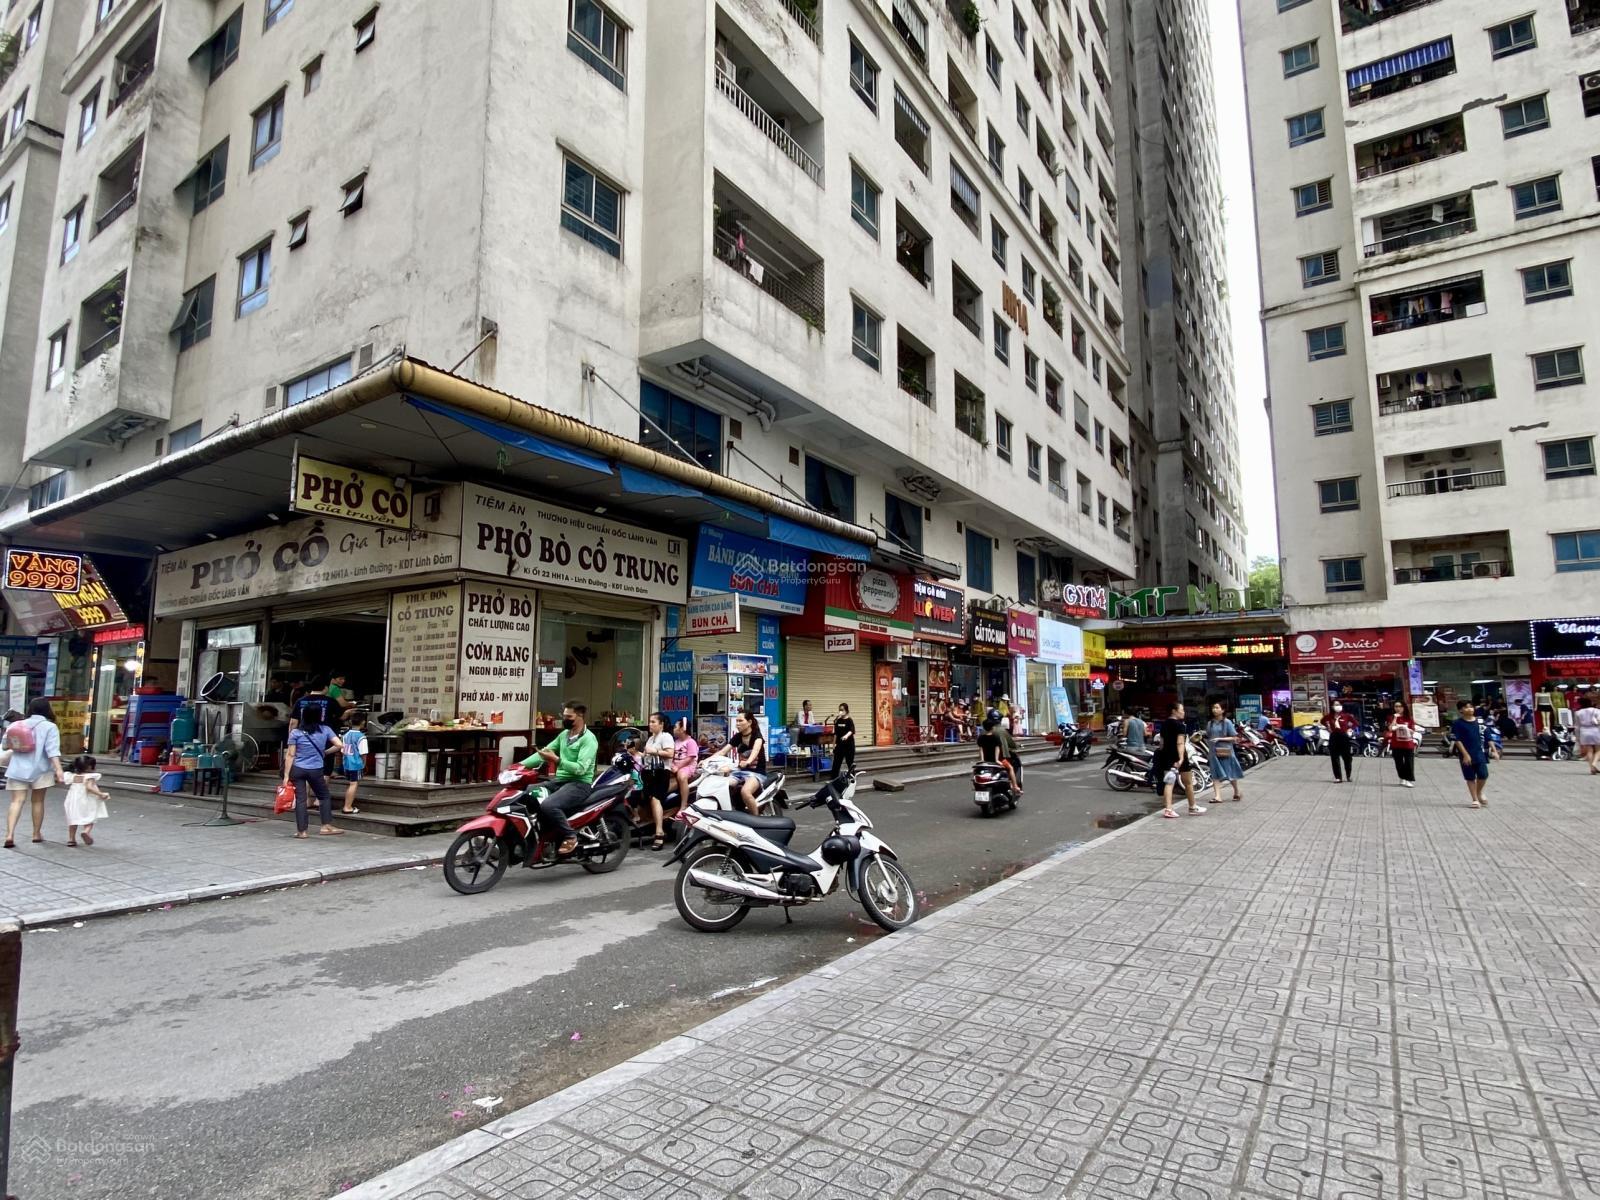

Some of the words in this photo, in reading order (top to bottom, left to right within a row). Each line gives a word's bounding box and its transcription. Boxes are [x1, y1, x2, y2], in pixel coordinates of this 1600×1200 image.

[301, 472, 365, 509] PHỞ
[314, 503, 341, 514] Gia
[475, 494, 505, 511] TIỆM
[508, 501, 526, 516] ĂN
[190, 539, 262, 589] PHỞ
[340, 533, 368, 555] Gia
[477, 520, 533, 559] PHỞ
[539, 533, 571, 566] BÒ
[613, 552, 679, 586] TRUNG
[708, 543, 738, 566] BÁNH
[11, 551, 78, 574] VÀNG
[161, 561, 177, 575] TIỆM
[177, 560, 188, 570] ĂN
[354, 564, 367, 576] Linh
[415, 556, 431, 566] Linh
[10, 570, 76, 590] 9999
[542, 570, 550, 578] 22
[552, 573, 570, 582] HH1A
[574, 576, 587, 584] Linh
[872, 576, 887, 587] pizza
[468, 588, 505, 615] PHỞ
[509, 593, 532, 618] BÒ
[1063, 584, 1106, 610] GYM
[76, 605, 105, 625] 9999
[415, 605, 454, 620] TRUNG
[711, 612, 729, 626] CHẢ
[468, 616, 488, 629] CHẤT
[489, 620, 514, 632] LƯỢNG
[516, 622, 530, 632] CAO
[974, 618, 985, 640] CẮT
[984, 623, 996, 643] TÓC
[996, 630, 1006, 645] NAM
[827, 636, 852, 650] pizza
[1328, 637, 1379, 651] Davito
[1486, 642, 1513, 650] beauty
[465, 641, 493, 660] CƠM
[495, 645, 530, 663] RANG
[677, 656, 692, 672] CUỐN
[468, 666, 491, 676] NGON
[492, 666, 508, 679] ĐẶC
[509, 666, 525, 678] BIỆT
[662, 680, 674, 691] CAO
[461, 689, 477, 702] PHỞ
